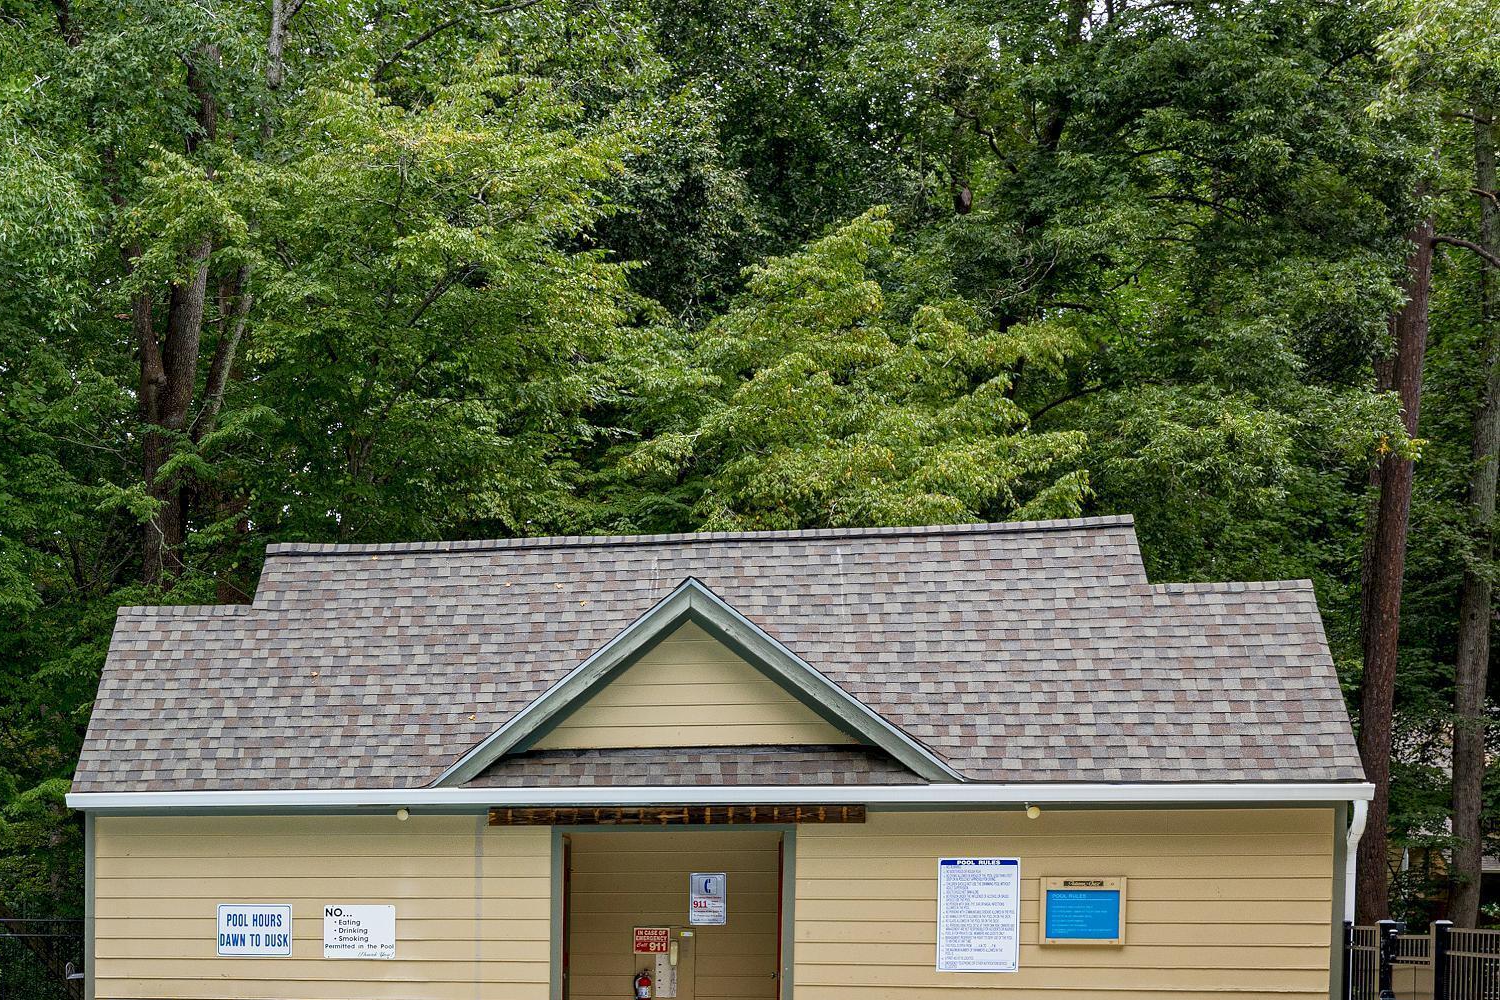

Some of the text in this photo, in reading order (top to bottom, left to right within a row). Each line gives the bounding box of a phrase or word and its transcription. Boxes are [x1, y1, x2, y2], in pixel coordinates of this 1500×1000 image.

[693, 900, 708, 908] 911
[226, 914, 282, 927] POOL HOURS
[220, 934, 289, 947] DAWN TO DUSK
[649, 942, 666, 951] 911
